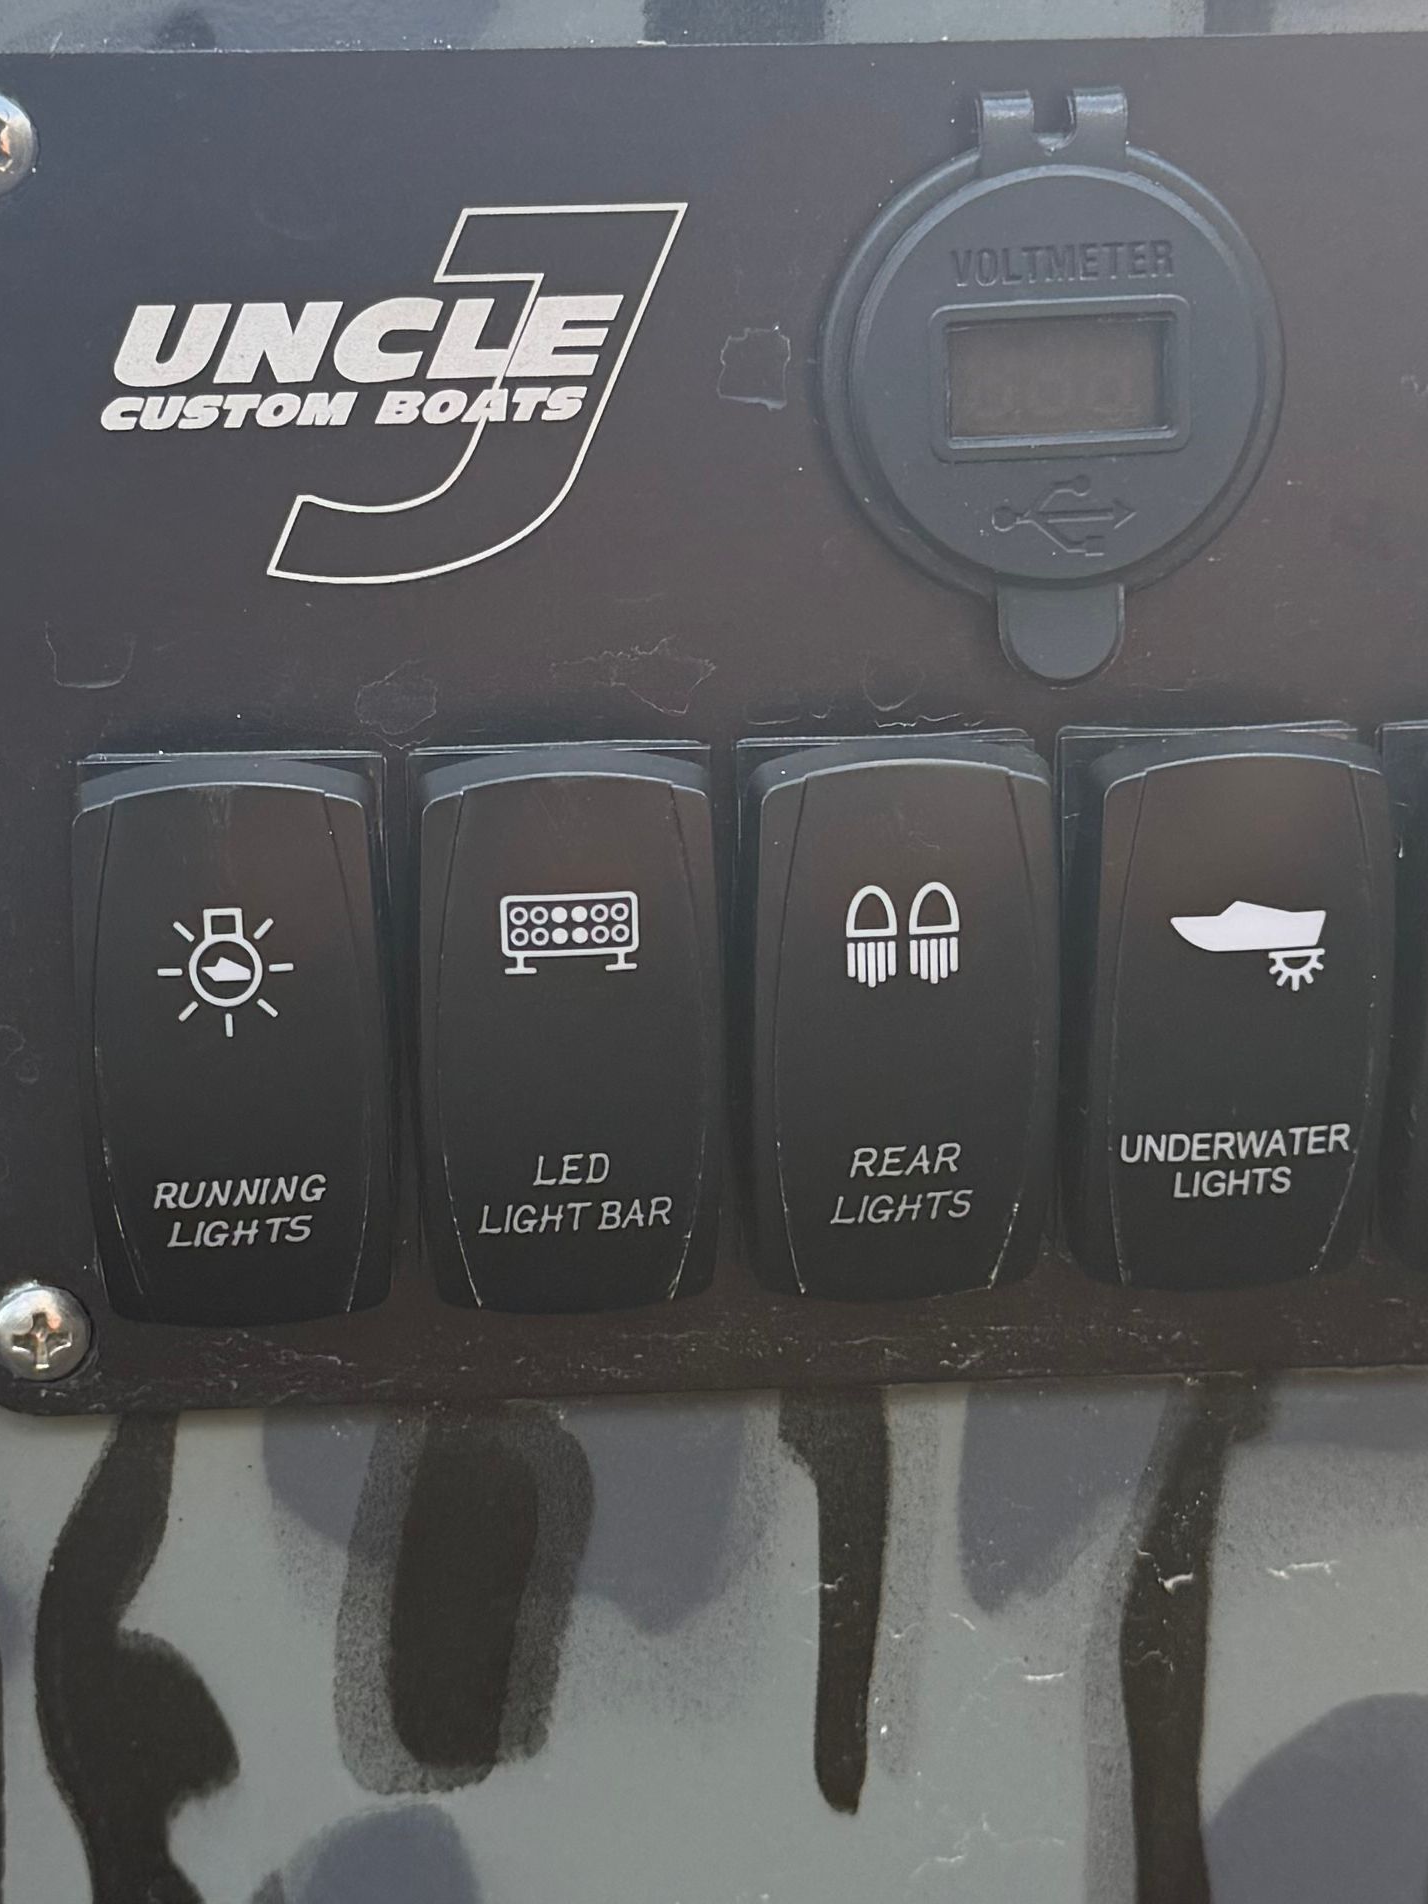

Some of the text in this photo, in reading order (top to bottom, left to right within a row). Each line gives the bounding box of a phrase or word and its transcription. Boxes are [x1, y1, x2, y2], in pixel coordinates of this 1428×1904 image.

[948, 237, 1177, 288] VOLTMETER
[100, 386, 588, 432] CUSTOM BOATS
[113, 202, 688, 584] UNCLE J
[849, 1141, 962, 1180] REAR
[1118, 1121, 1352, 1164] UNDERWATER
[533, 1152, 611, 1189] LED
[1172, 1166, 1292, 1200] LIGHTS
[153, 1172, 328, 1212] RUNNING
[830, 1187, 974, 1225] LIGHTS
[166, 1213, 315, 1249] LIGHTS
[478, 1194, 673, 1236] LIGHT BAR
